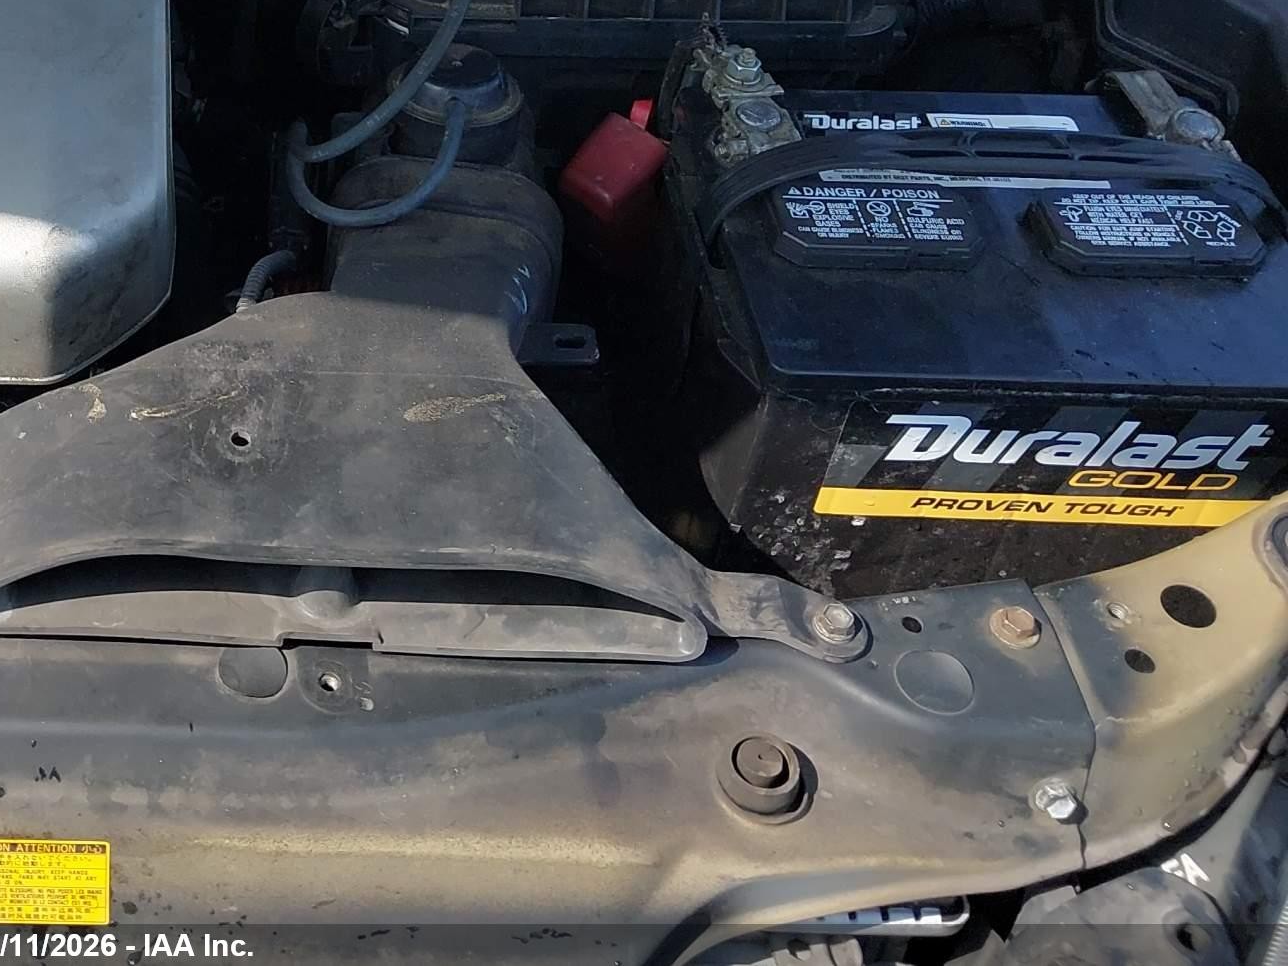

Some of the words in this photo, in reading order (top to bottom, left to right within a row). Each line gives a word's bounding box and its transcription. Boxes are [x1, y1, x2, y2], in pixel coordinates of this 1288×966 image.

[803, 113, 922, 132] Duralast
[803, 186, 867, 198] DANGER
[870, 188, 877, 198] /
[882, 188, 940, 199] POISON
[946, 218, 965, 226] ACID
[884, 413, 1270, 472] Duralast
[1068, 470, 1240, 490] GOLD
[911, 496, 1054, 514] PROVEN
[16, 844, 76, 854] ATTENTION
